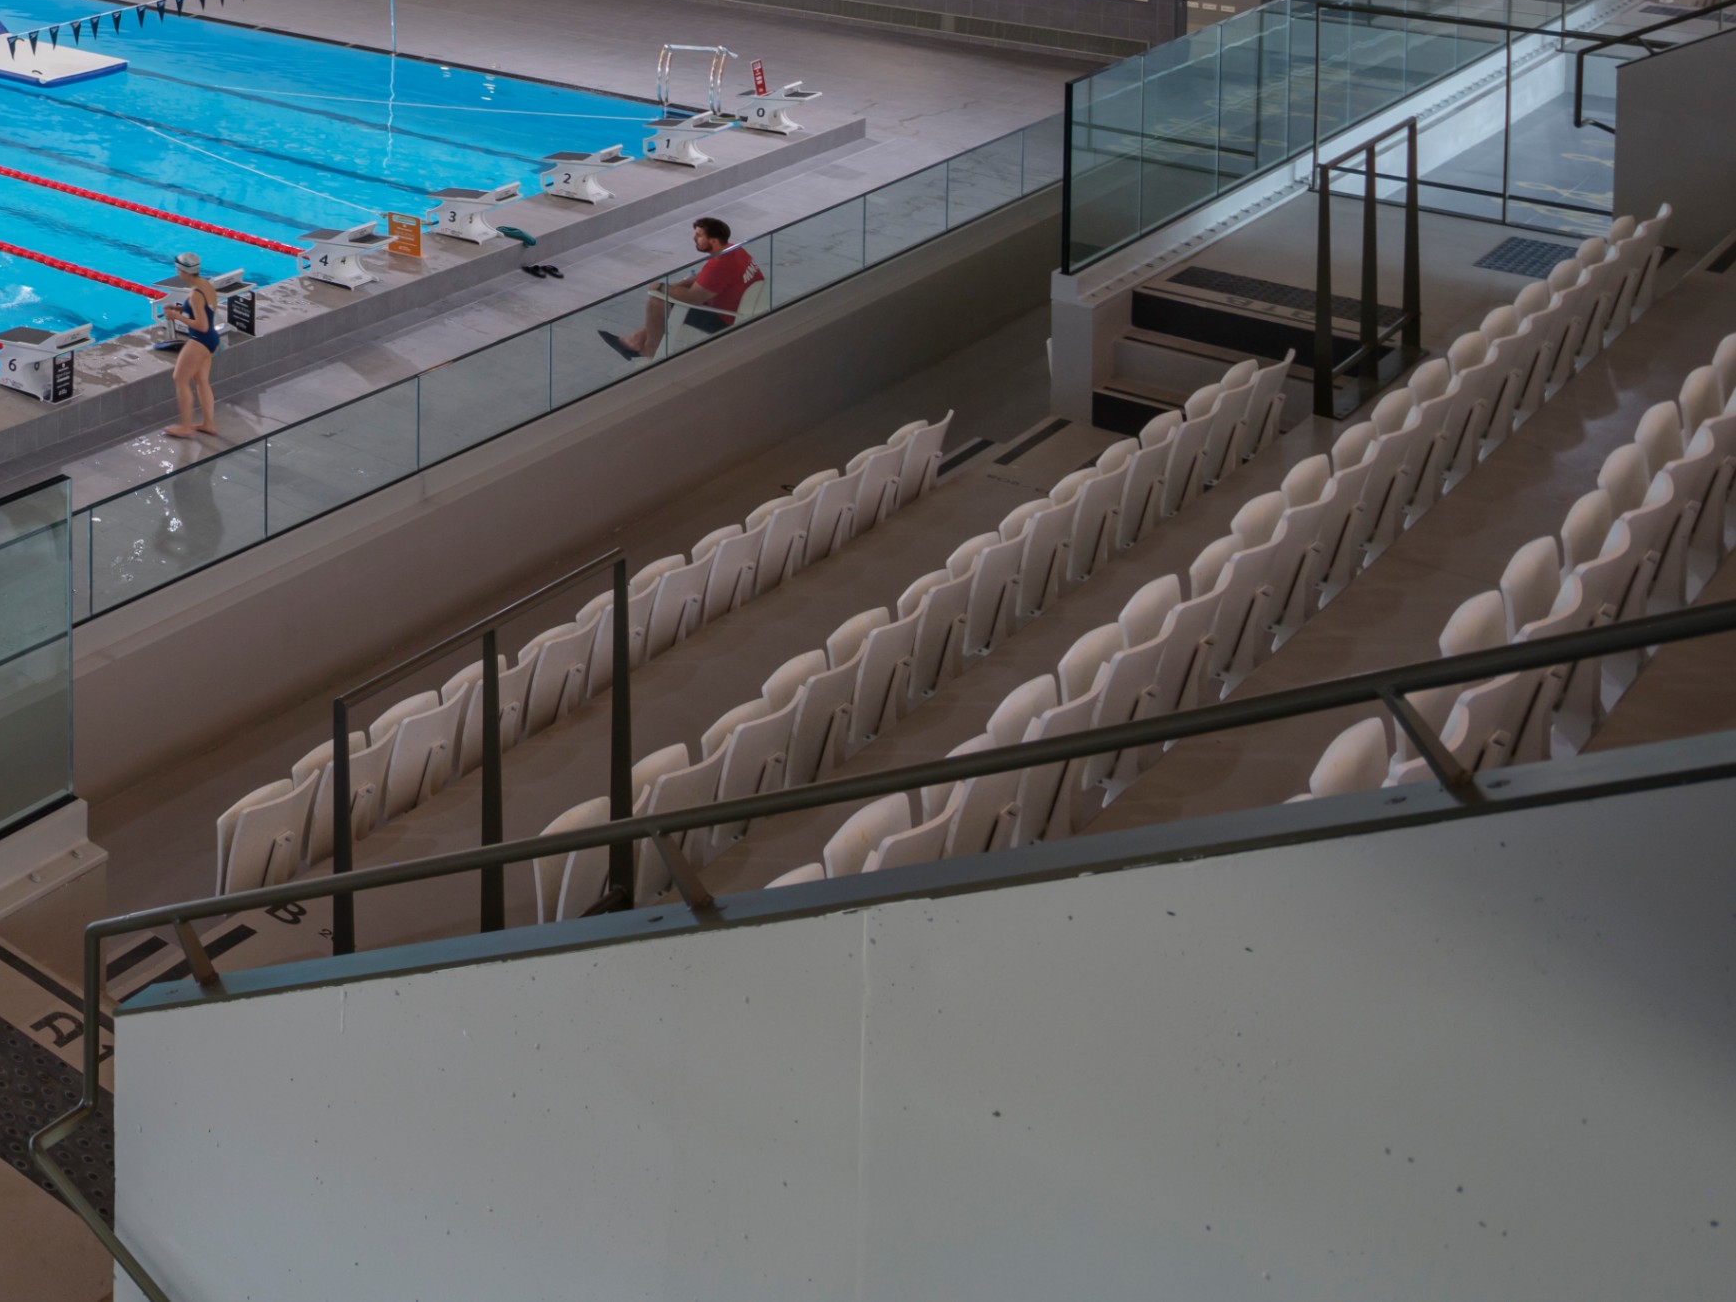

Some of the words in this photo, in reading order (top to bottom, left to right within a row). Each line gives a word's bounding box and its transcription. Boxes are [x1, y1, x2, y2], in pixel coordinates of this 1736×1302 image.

[756, 107, 765, 118] 0
[665, 138, 671, 149] 1
[562, 173, 572, 184] 2
[448, 211, 457, 223] 3
[319, 254, 329, 267] 4
[8, 358, 17, 372] 6
[264, 900, 307, 925] B
